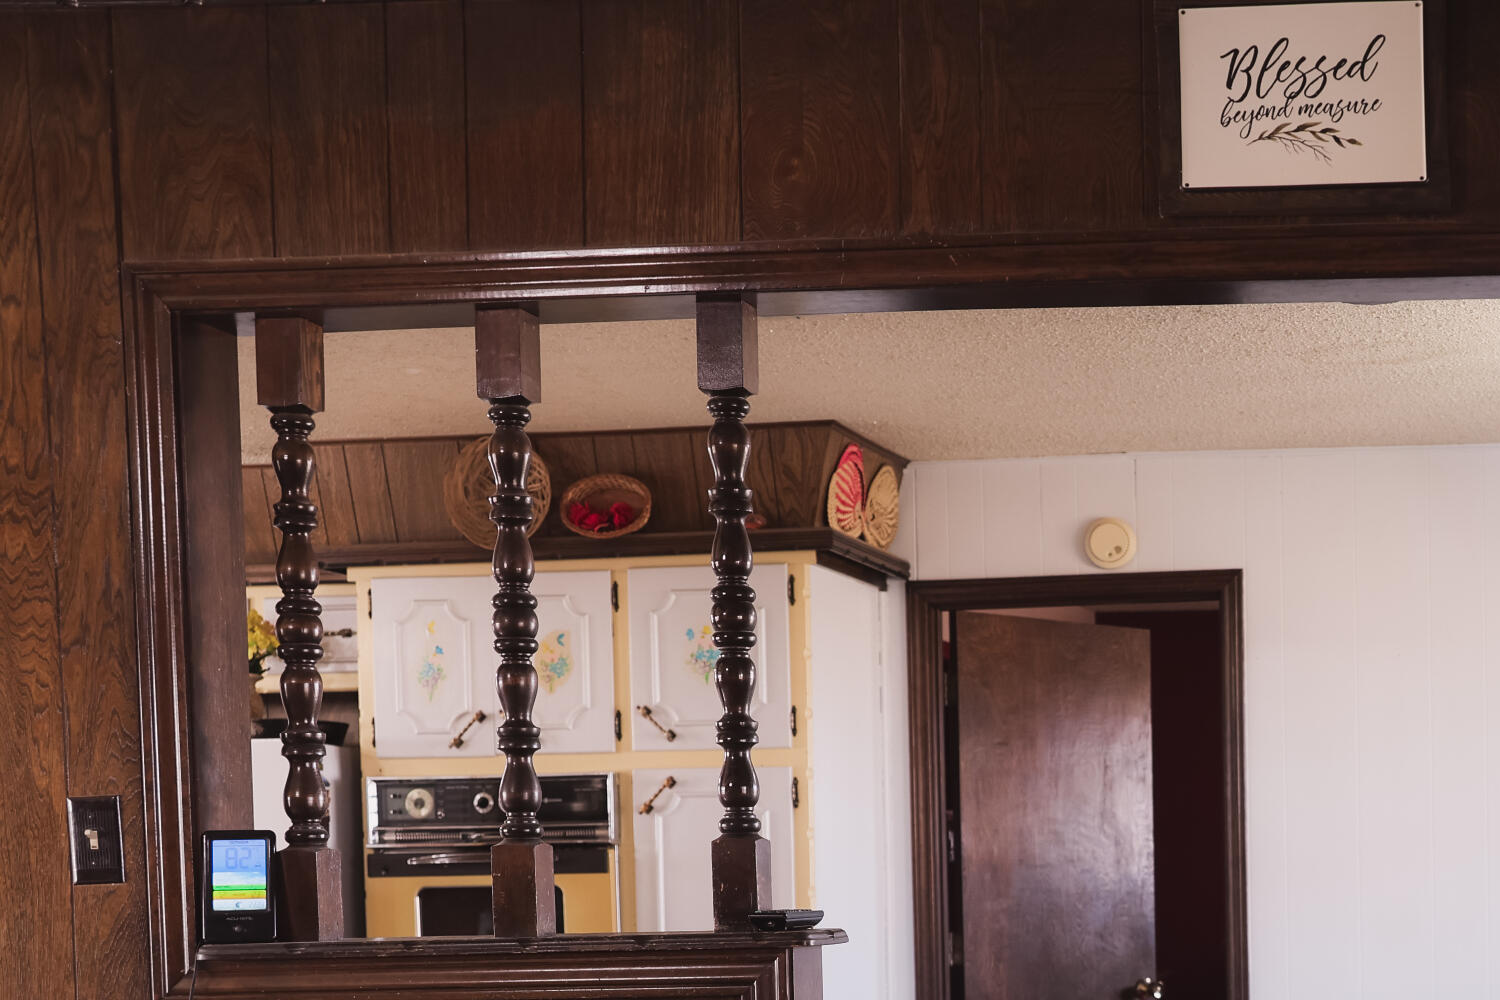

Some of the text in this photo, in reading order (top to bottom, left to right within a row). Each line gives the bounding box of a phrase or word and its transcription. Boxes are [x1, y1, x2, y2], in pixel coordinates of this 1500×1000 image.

[1220, 34, 1386, 103] Blessed
[1220, 91, 1382, 139] beyond measure
[225, 847, 252, 869] 82
